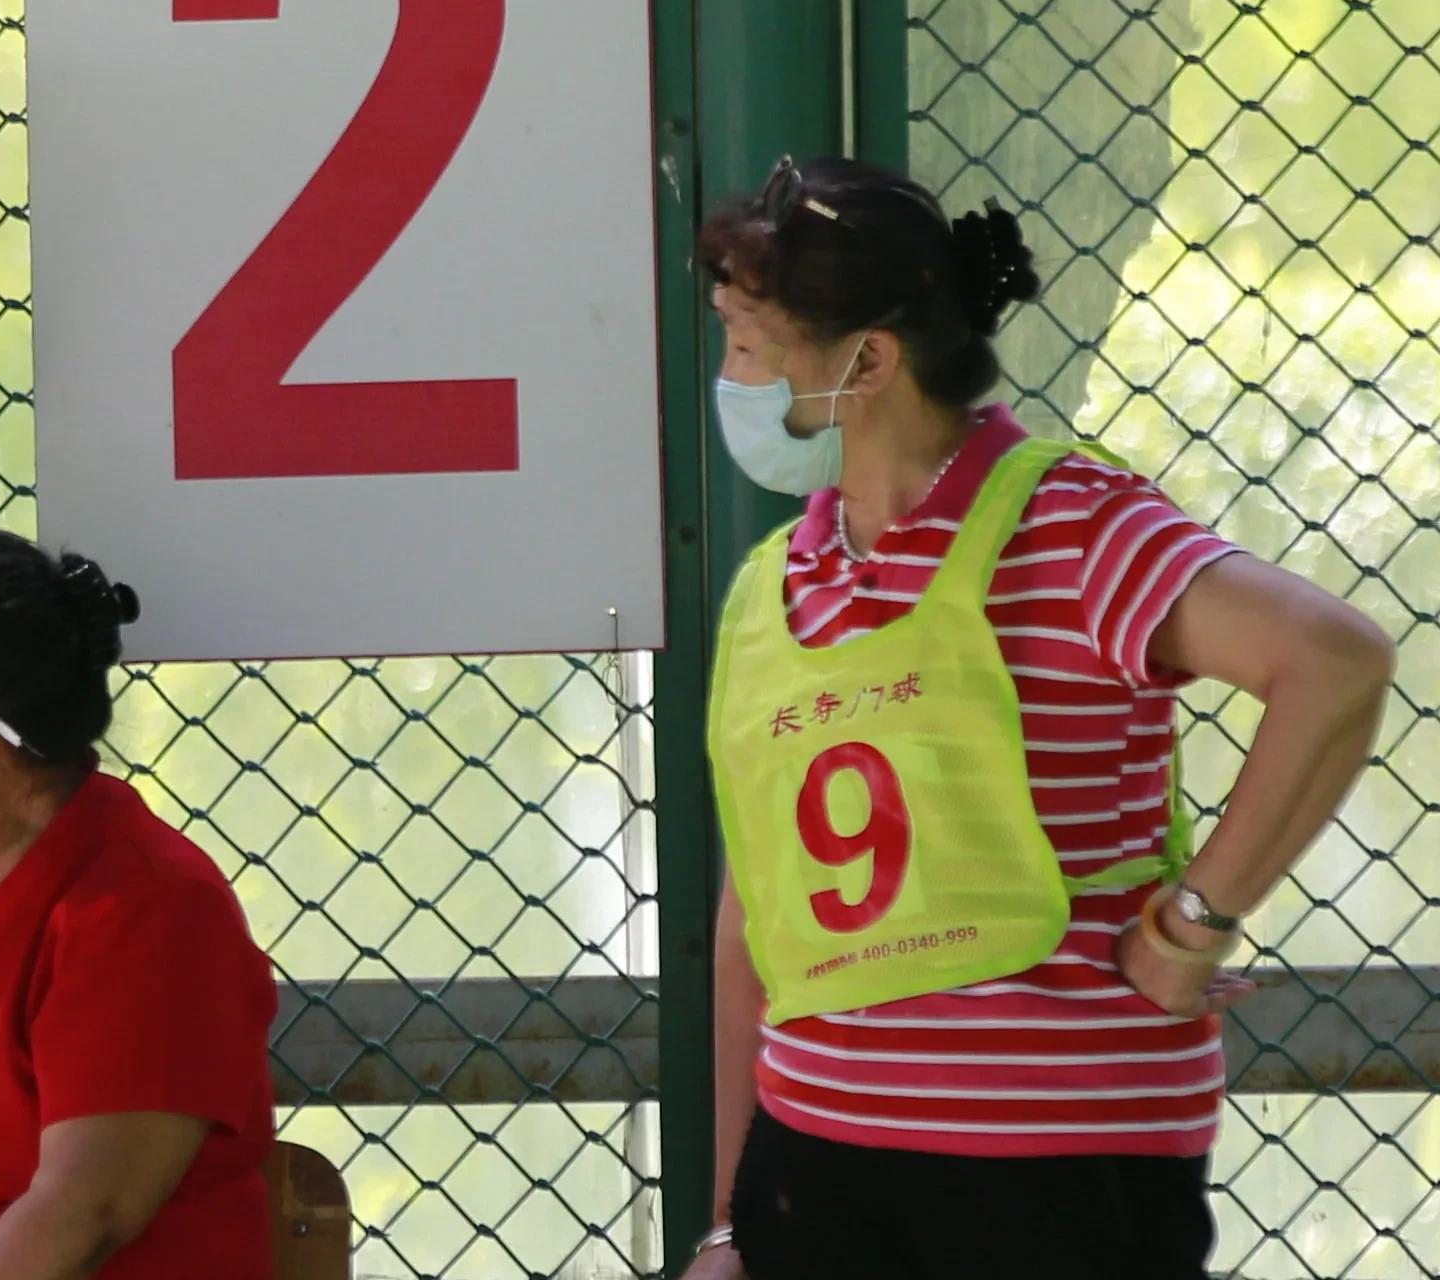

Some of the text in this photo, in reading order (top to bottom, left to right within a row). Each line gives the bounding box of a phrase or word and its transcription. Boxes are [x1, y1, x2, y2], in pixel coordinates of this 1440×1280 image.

[769, 671, 923, 739] 长寿门球
[796, 741, 913, 934] 9
